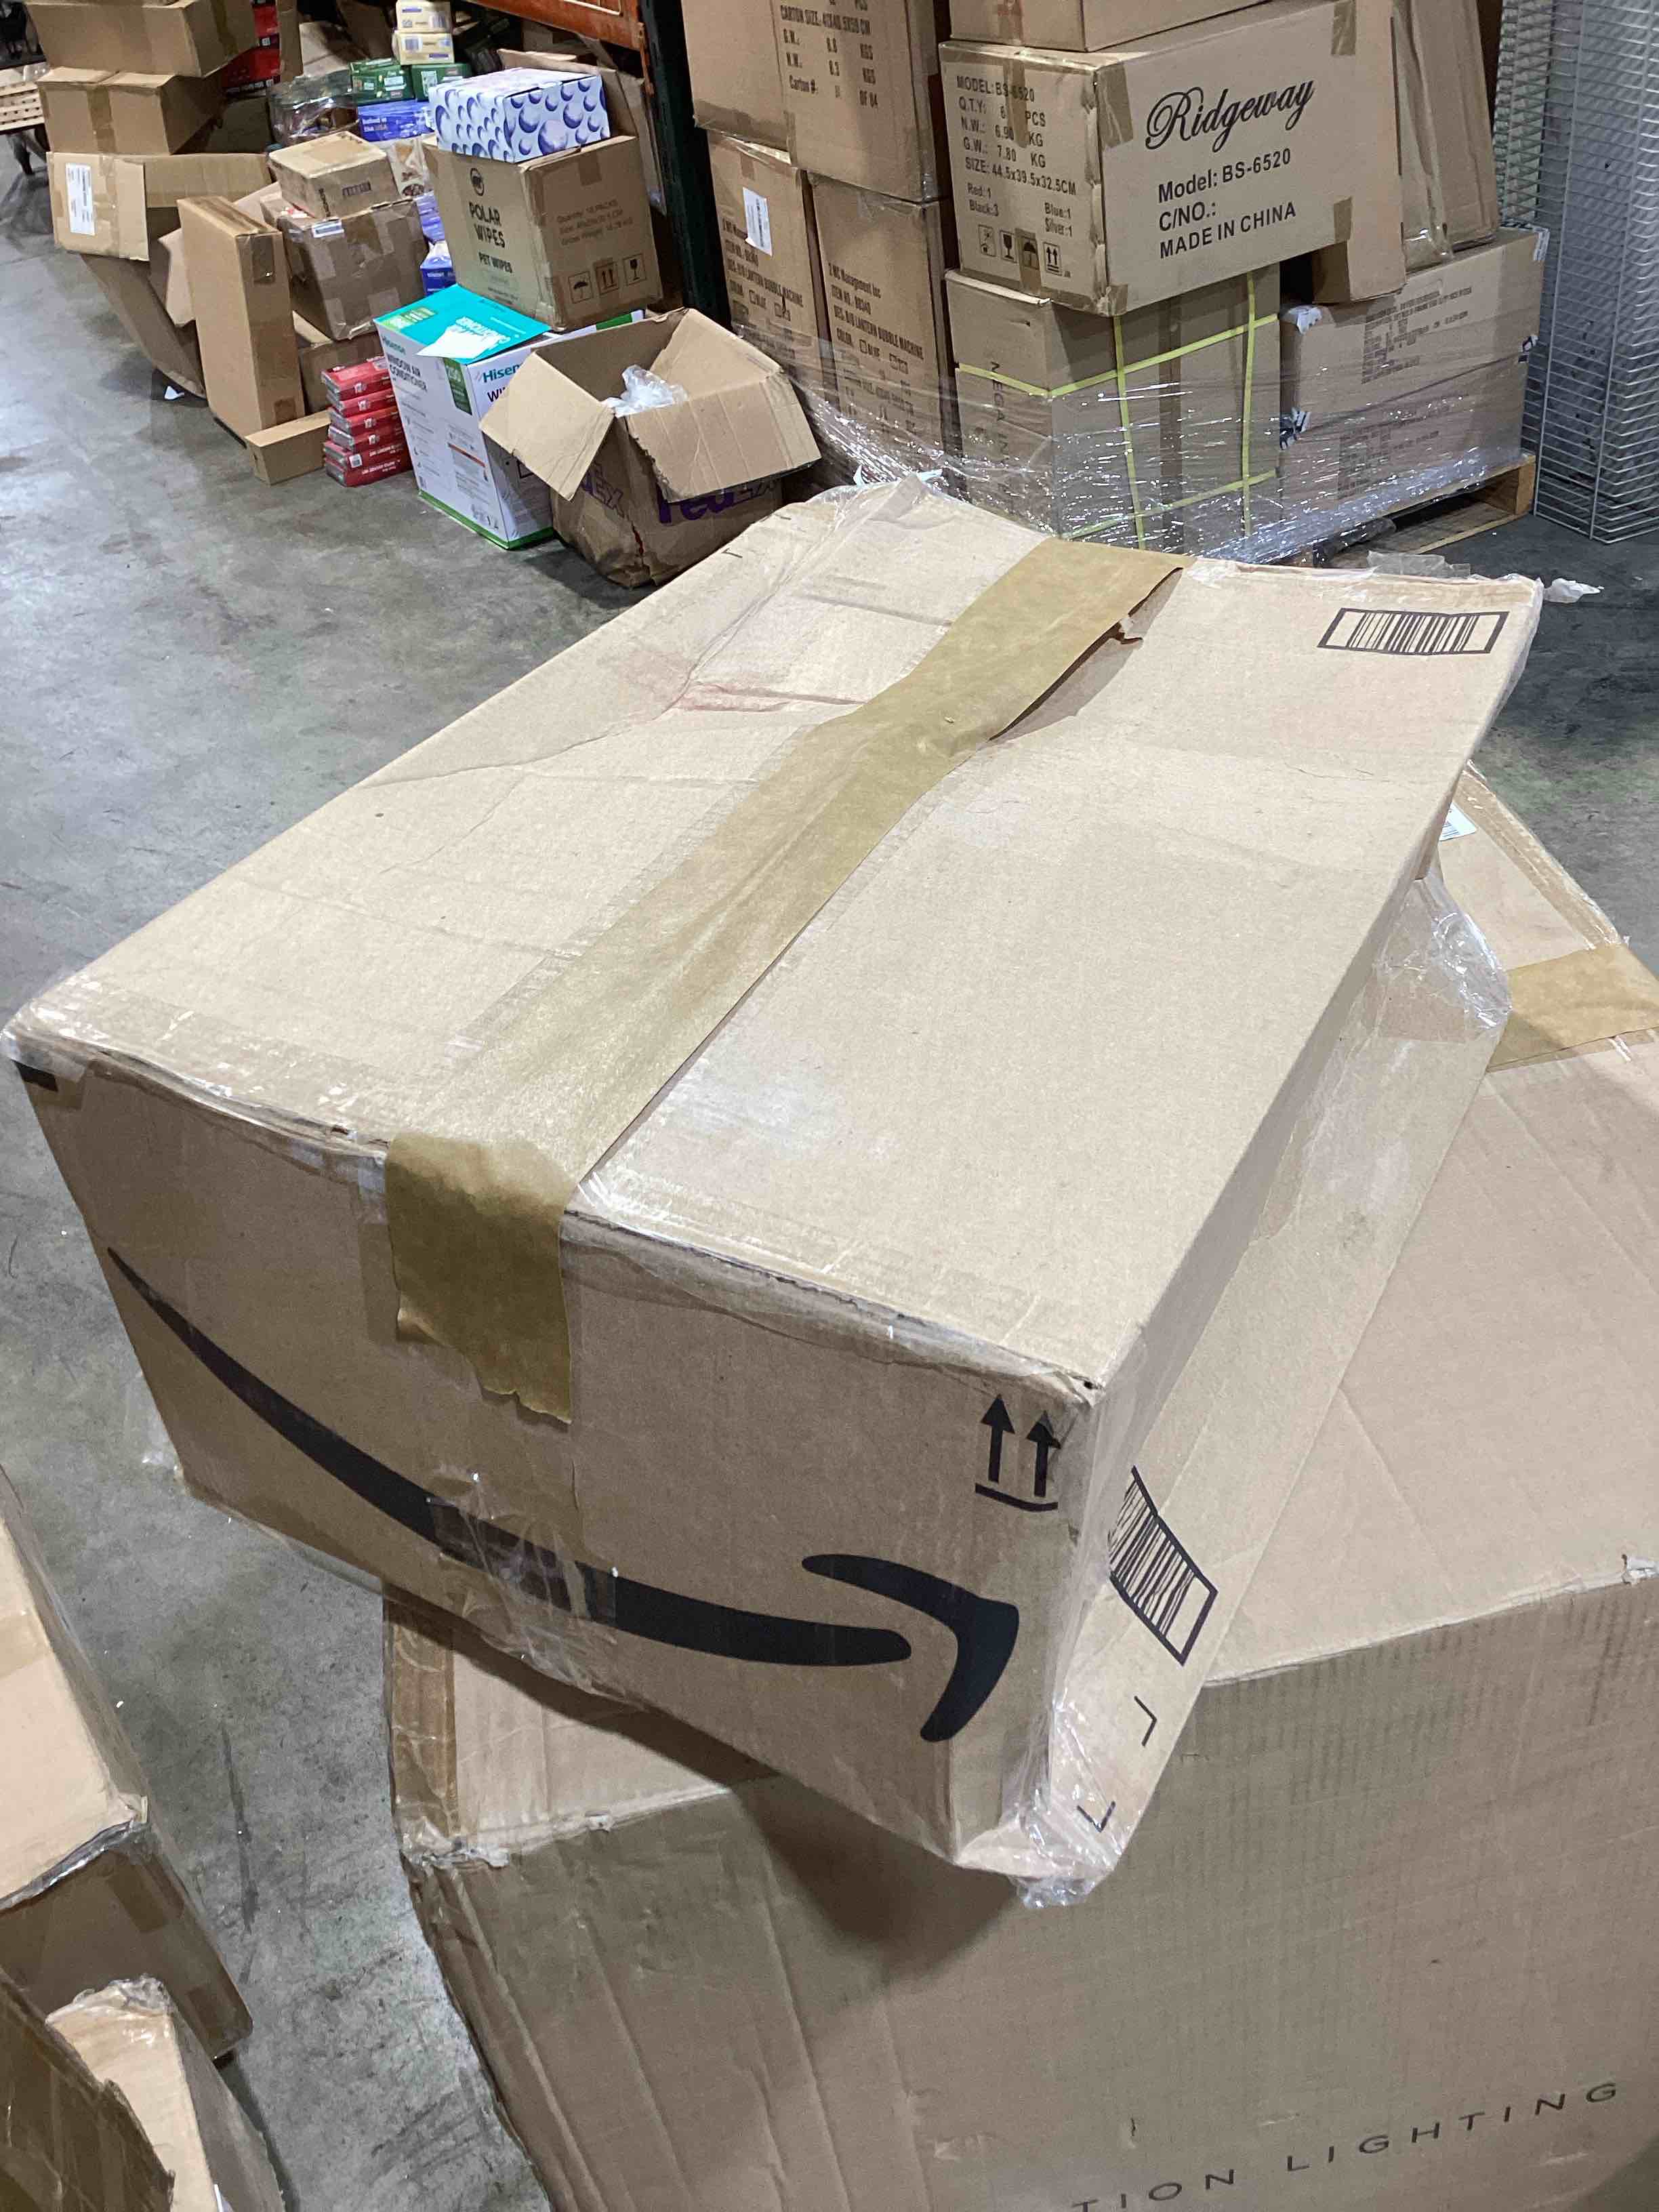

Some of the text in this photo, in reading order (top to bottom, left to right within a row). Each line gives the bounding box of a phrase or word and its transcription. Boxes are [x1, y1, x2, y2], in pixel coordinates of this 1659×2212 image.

[780, 5, 804, 23] CARTON
[957, 75, 994, 94] MODEL:
[1025, 110, 1046, 127] PCS
[1145, 80, 1316, 153] Ridgeway
[1029, 132, 1044, 147] KG
[1030, 152, 1046, 168] KG
[1158, 147, 1292, 203] Model: BS-6520
[469, 201, 502, 226] POLAR
[474, 224, 506, 249] WIPES
[1160, 201, 1297, 259] MADE IN CHINA
[478, 251, 513, 273] PET WIPES
[1287, 2081, 1618, 2171] LIGHTING
